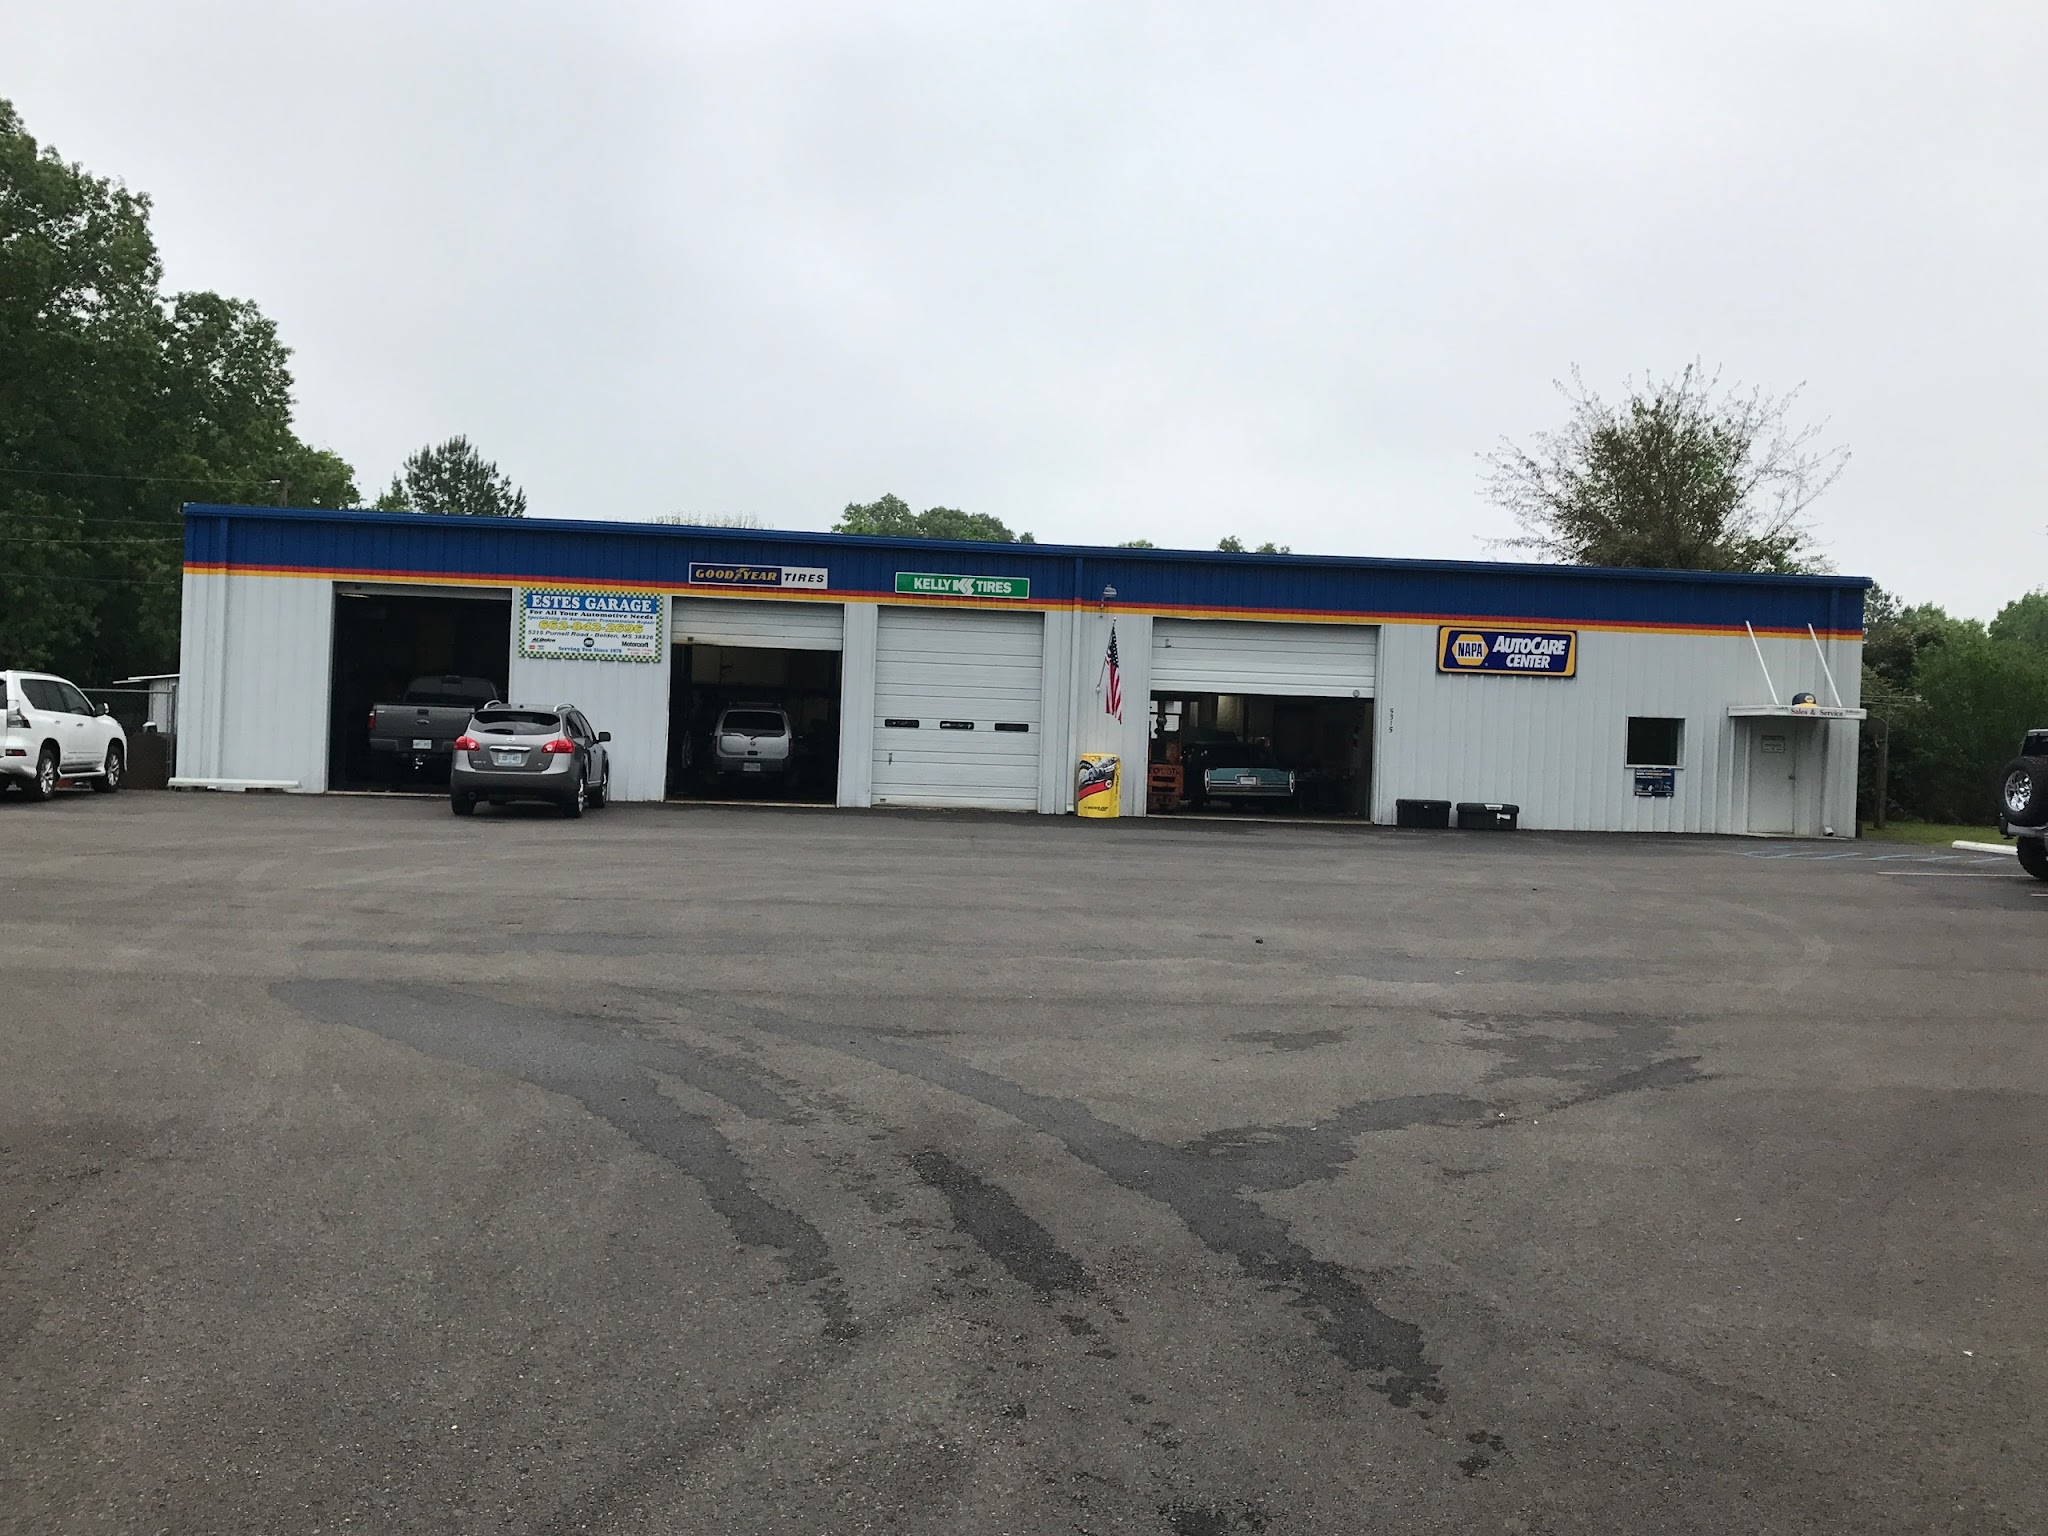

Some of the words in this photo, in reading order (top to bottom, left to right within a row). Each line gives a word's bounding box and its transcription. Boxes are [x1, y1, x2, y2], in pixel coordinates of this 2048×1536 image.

[695, 568, 777, 582] GOODYEAR
[784, 573, 825, 583] TIRES
[914, 577, 951, 590] KELLY
[976, 581, 1012, 593] TIRES
[531, 594, 580, 609] ESTES
[584, 597, 652, 612] GARAGE
[1457, 642, 1483, 658] NAPA
[1506, 654, 1551, 669] CENTER
[1820, 709, 1844, 717] Service
